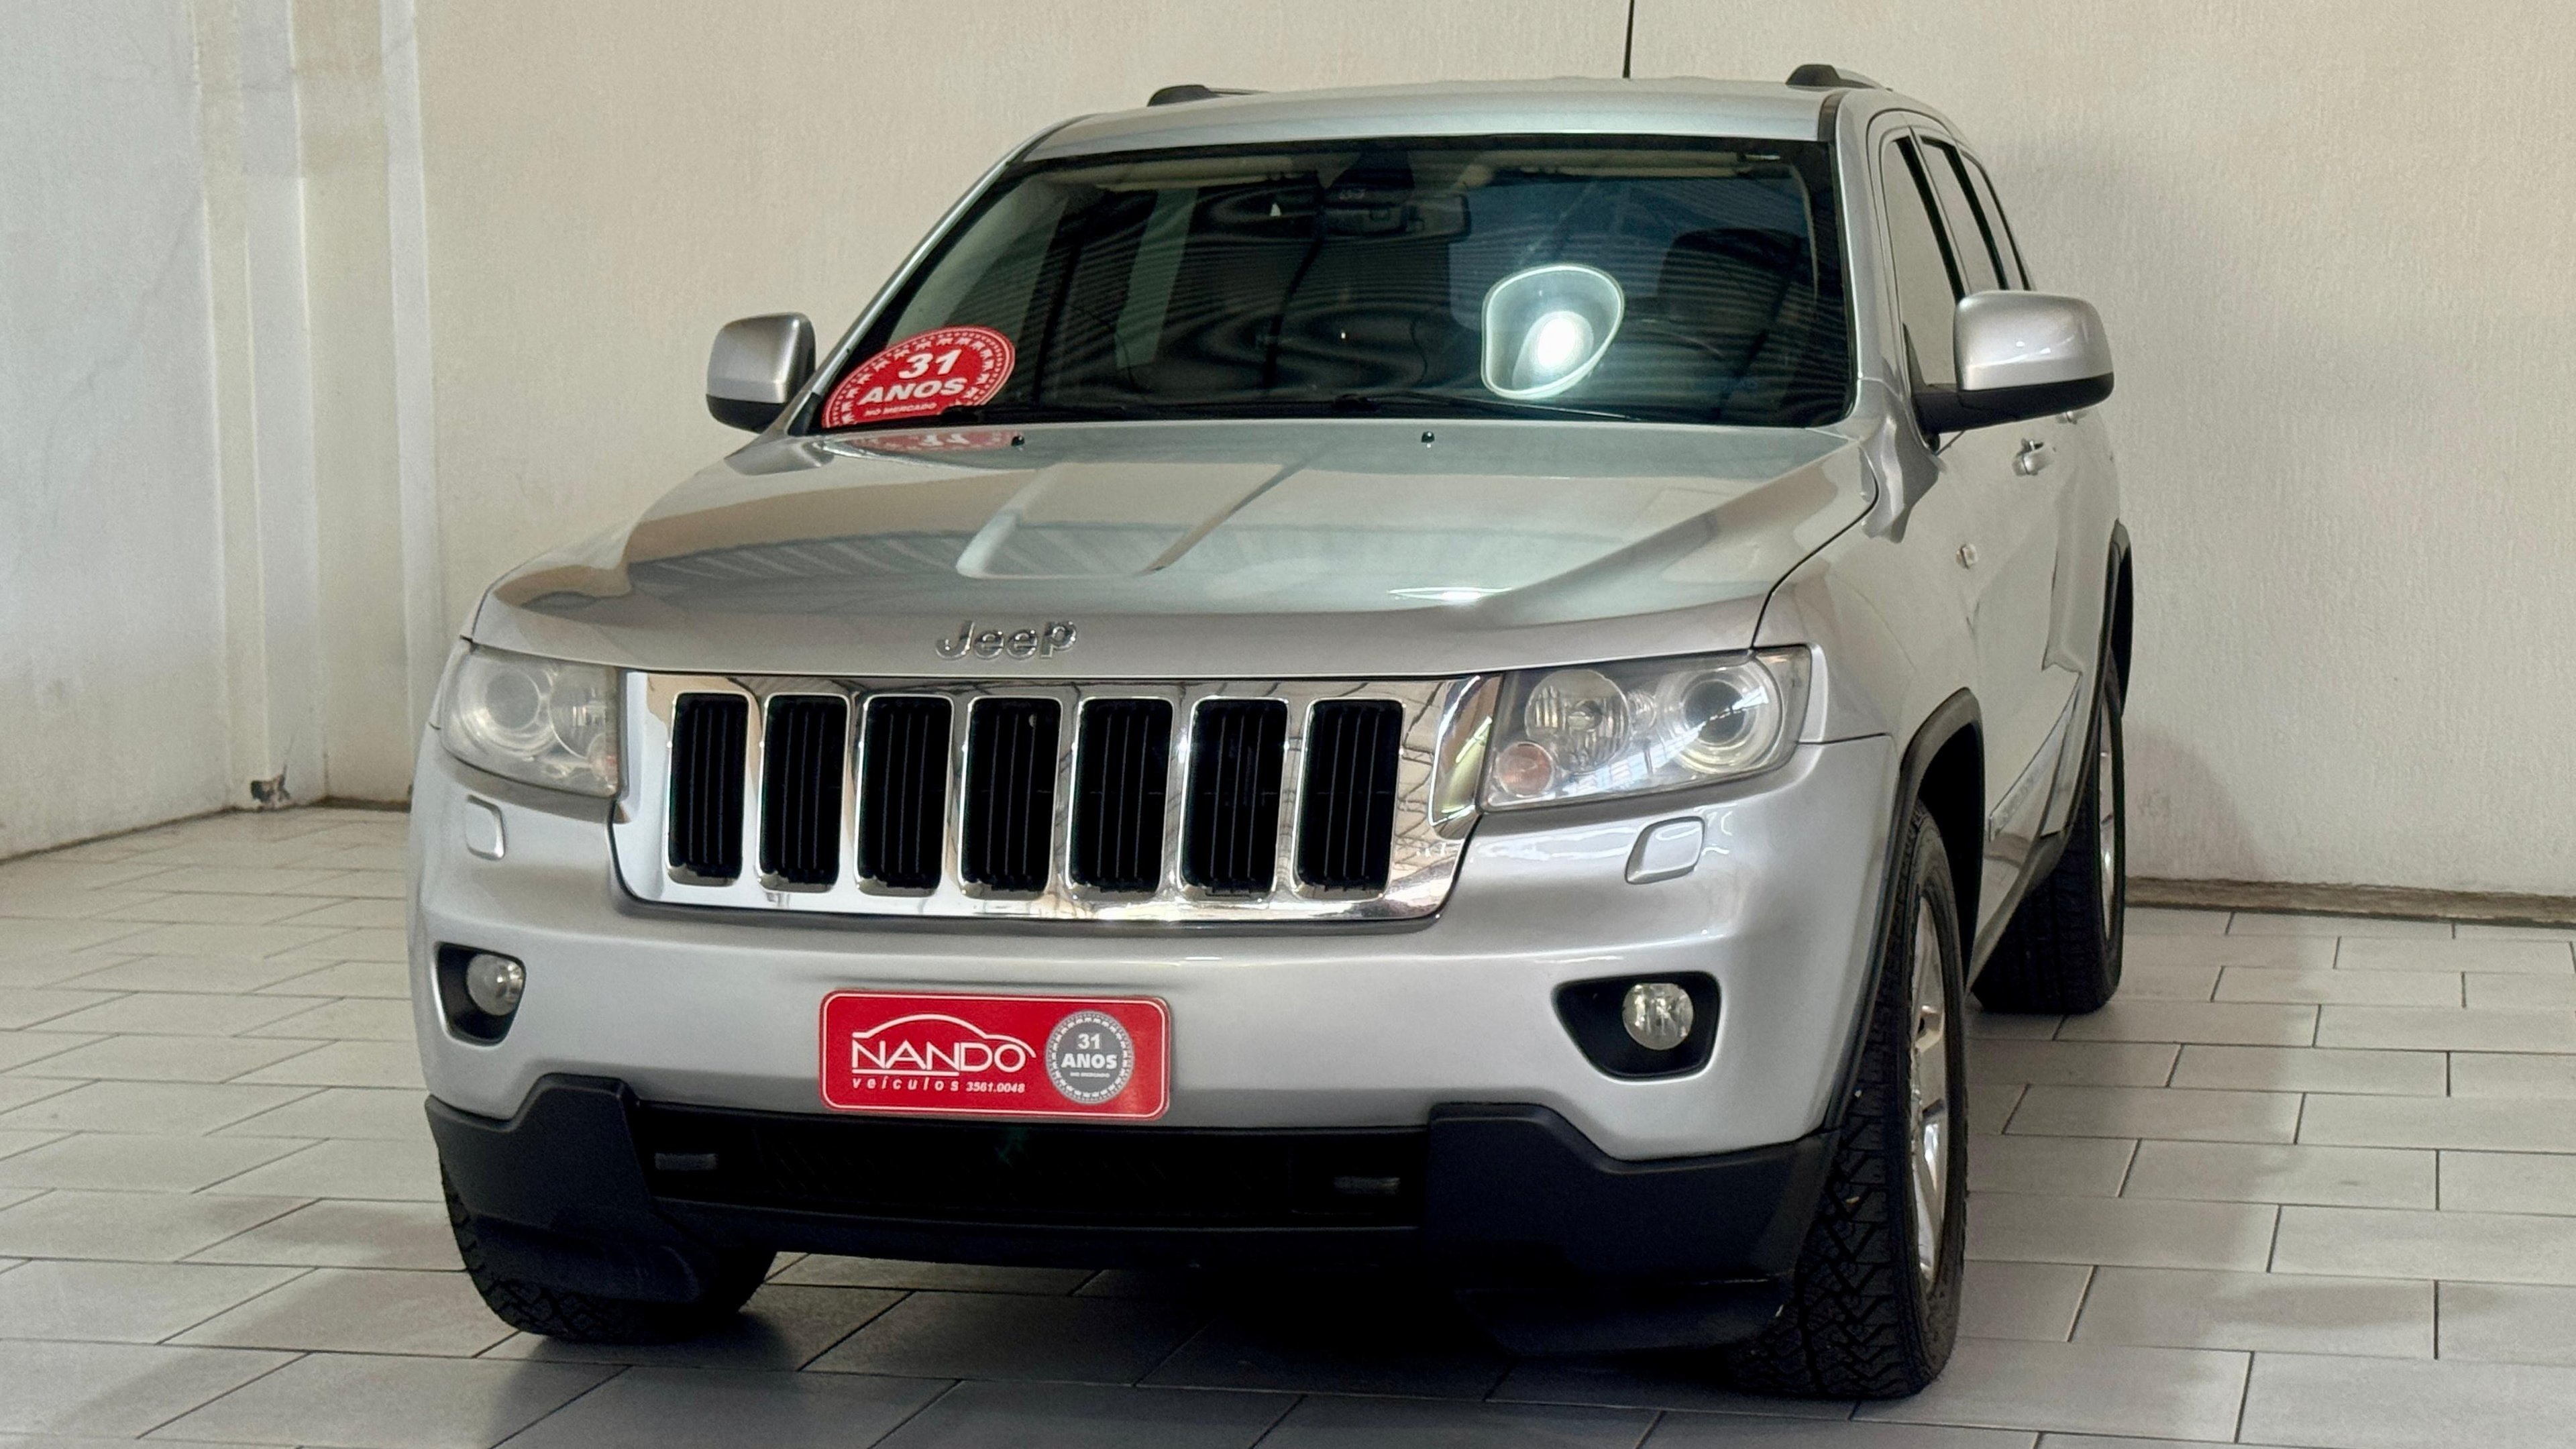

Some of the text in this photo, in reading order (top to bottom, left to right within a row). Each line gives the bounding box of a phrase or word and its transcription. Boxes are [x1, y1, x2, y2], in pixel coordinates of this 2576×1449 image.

[898, 349, 962, 379] 31
[856, 377, 967, 406] ANOS
[864, 402, 937, 416] NO MERCADO
[936, 620, 1077, 660] Jeep
[1077, 1033, 1100, 1050] 31
[852, 1040, 1026, 1073] NANDO
[1061, 1053, 1118, 1069] ANOS
[852, 1076, 1026, 1093] veículos 3561.0048
